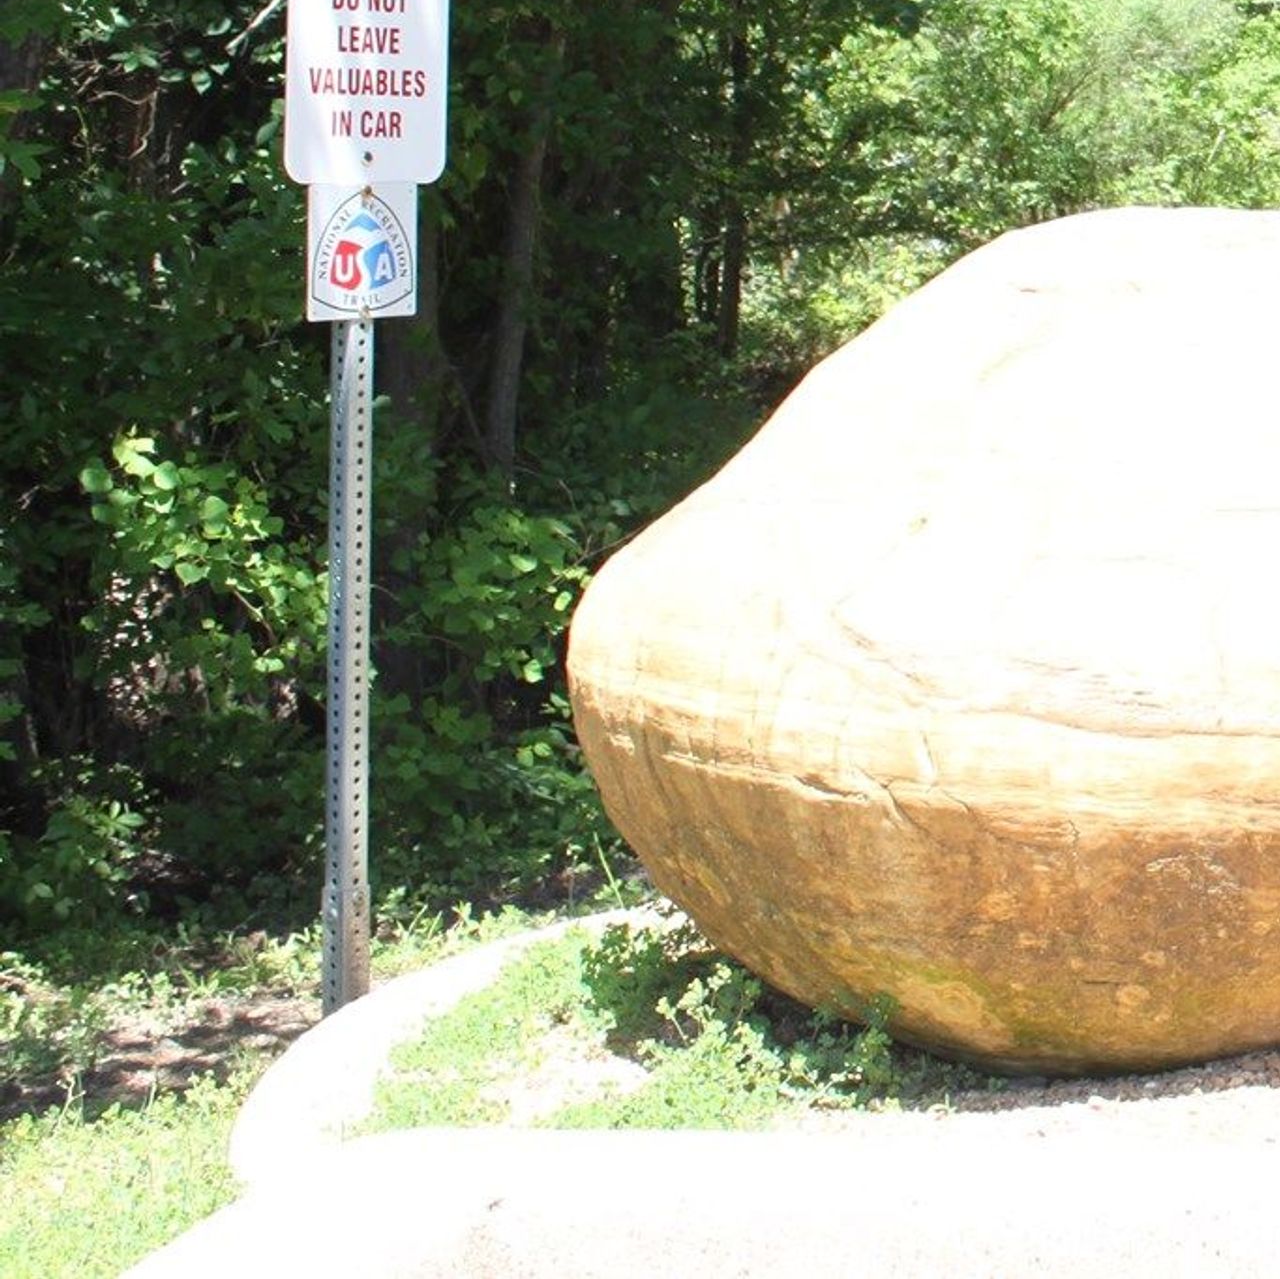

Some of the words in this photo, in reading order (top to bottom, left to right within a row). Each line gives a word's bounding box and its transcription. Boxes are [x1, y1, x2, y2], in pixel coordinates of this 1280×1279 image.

[338, 25, 400, 54] LEAVE
[309, 67, 426, 97] VALUABLES
[332, 110, 352, 137] IN
[361, 110, 402, 138] CAR
[318, 208, 353, 280] NATIONAL
[335, 241, 395, 286] USA
[343, 294, 380, 305] TRAIL
